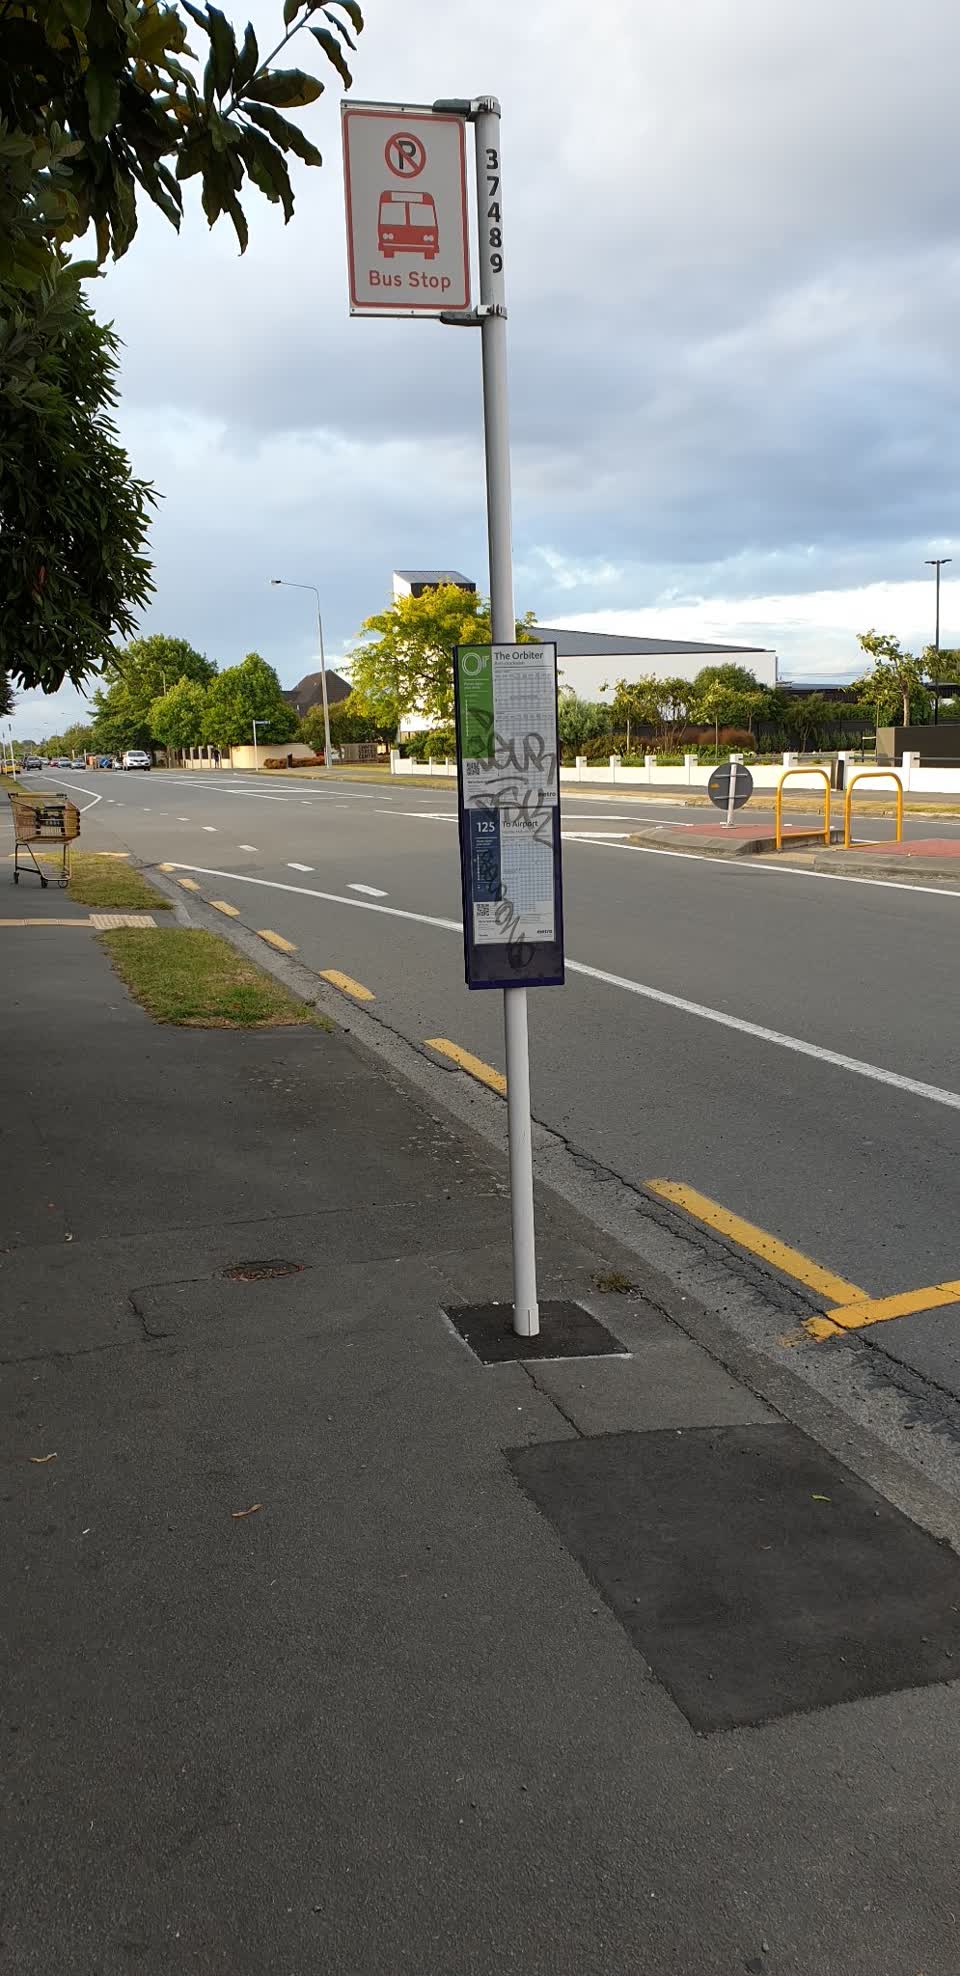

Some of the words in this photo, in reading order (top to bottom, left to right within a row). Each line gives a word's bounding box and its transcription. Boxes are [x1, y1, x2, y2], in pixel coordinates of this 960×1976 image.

[486, 149, 503, 273] 37489
[369, 270, 402, 287] Bus
[408, 271, 451, 292] Stop
[494, 651, 511, 660] The
[512, 651, 544, 660] Orbiter
[477, 822, 495, 832] 125
[512, 820, 539, 829] Airport
